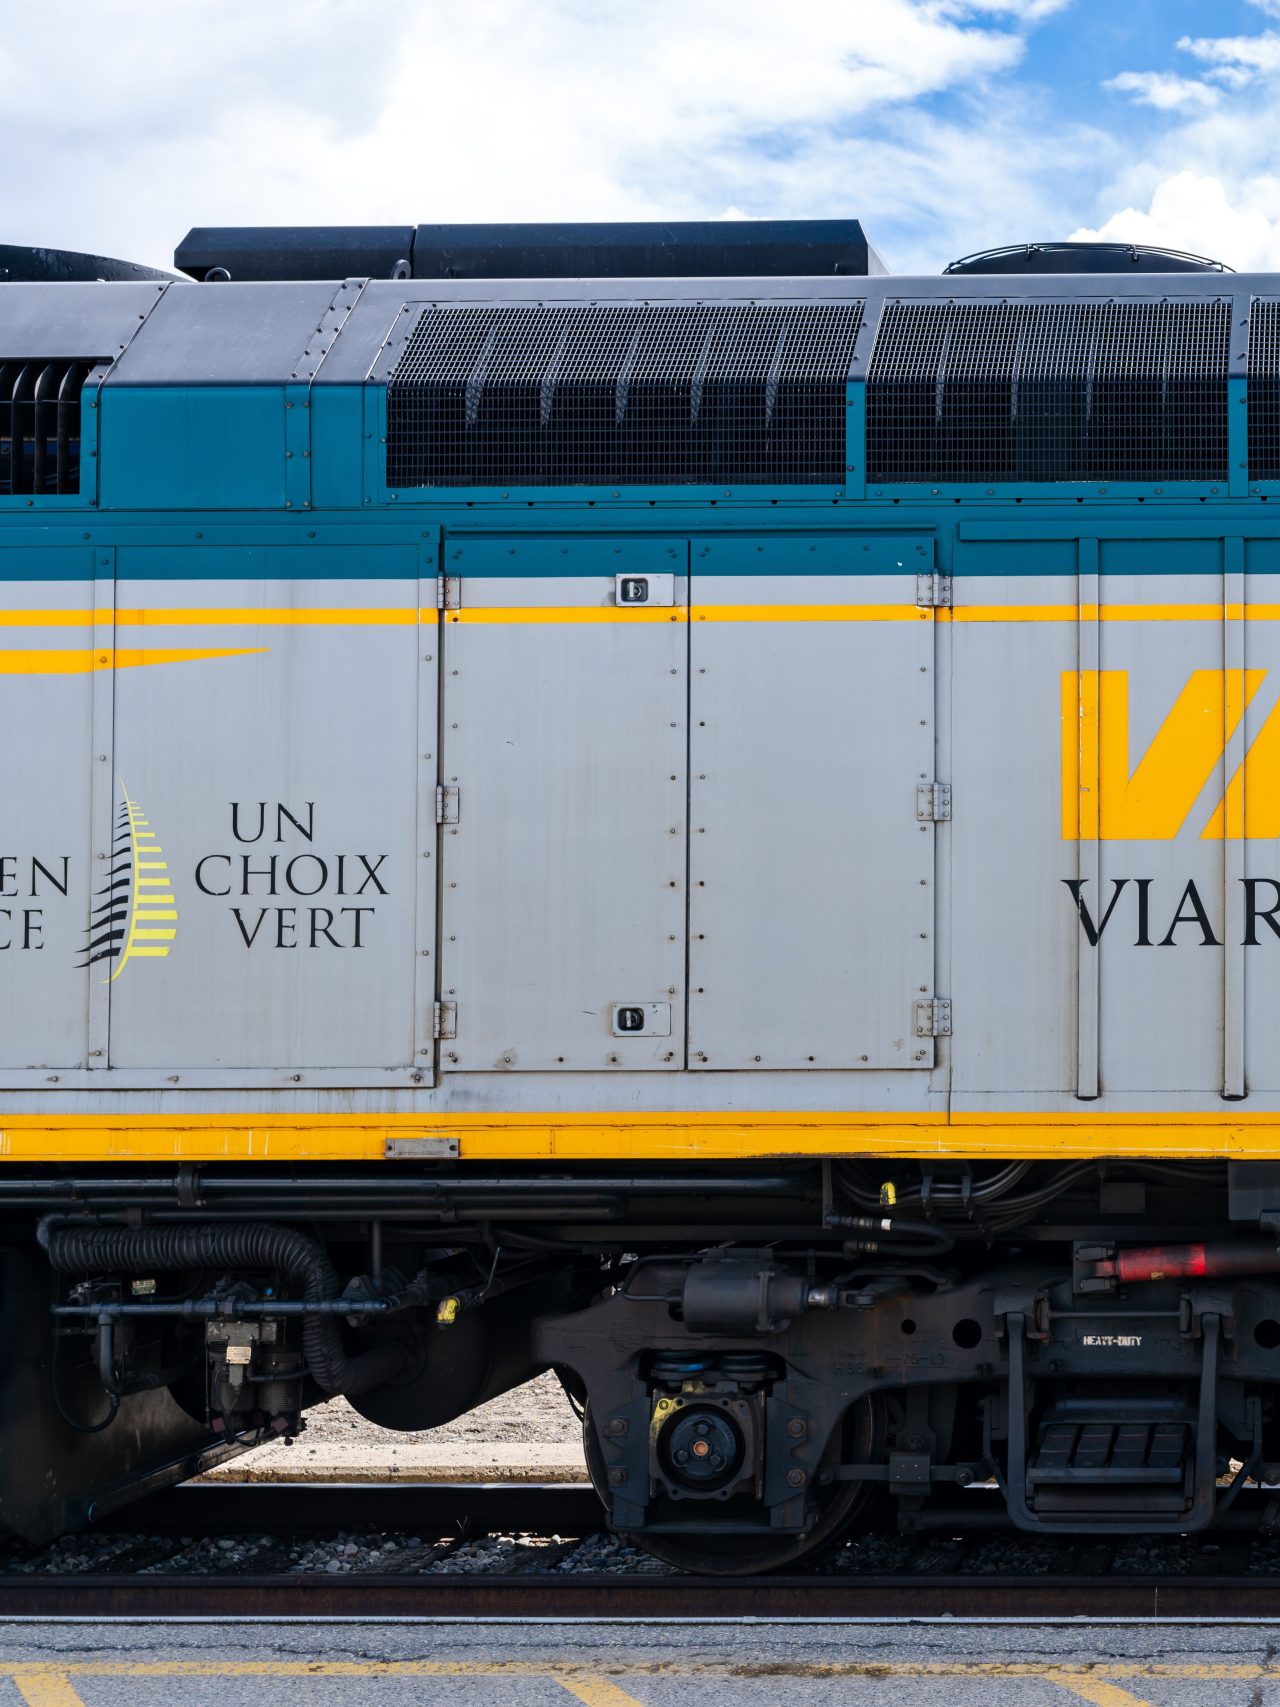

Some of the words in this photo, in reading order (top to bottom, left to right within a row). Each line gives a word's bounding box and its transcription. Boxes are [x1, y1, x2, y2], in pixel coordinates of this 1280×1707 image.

[230, 801, 315, 843] UN
[0, 856, 71, 897] EN
[194, 853, 390, 896] CHOIX
[229, 906, 375, 949] VERT
[1061, 878, 1224, 946] VIA
[1083, 1335, 1142, 1346] HEAVY-DUTY
